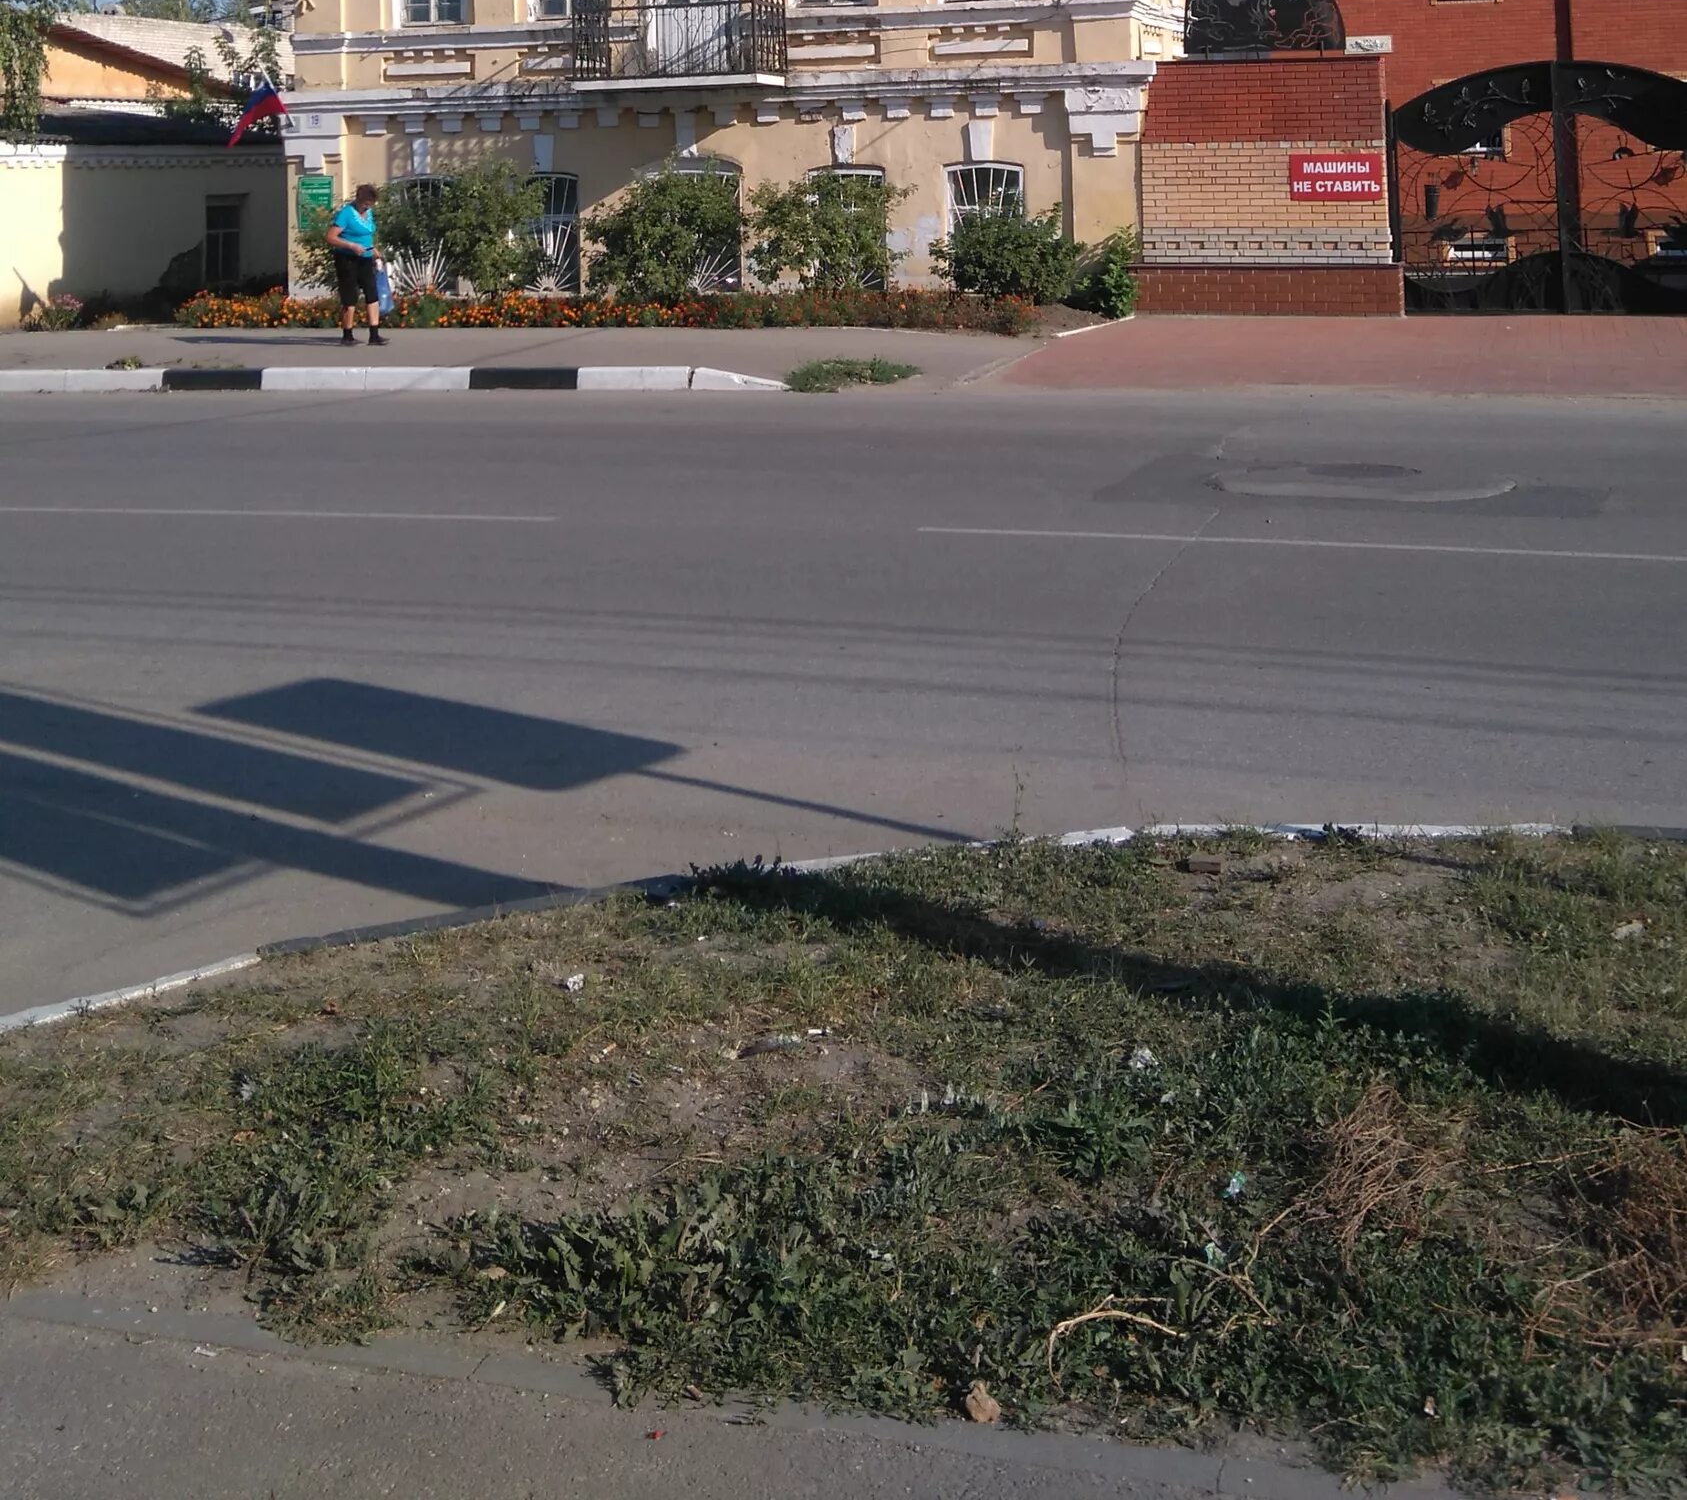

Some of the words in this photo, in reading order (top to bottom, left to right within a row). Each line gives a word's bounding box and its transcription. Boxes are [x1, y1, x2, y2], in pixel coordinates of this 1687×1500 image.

[1303, 162, 1370, 173] МАШИНЫ
[1293, 181, 1312, 192] НЕ
[1315, 181, 1381, 192] СТАВИТЬ
